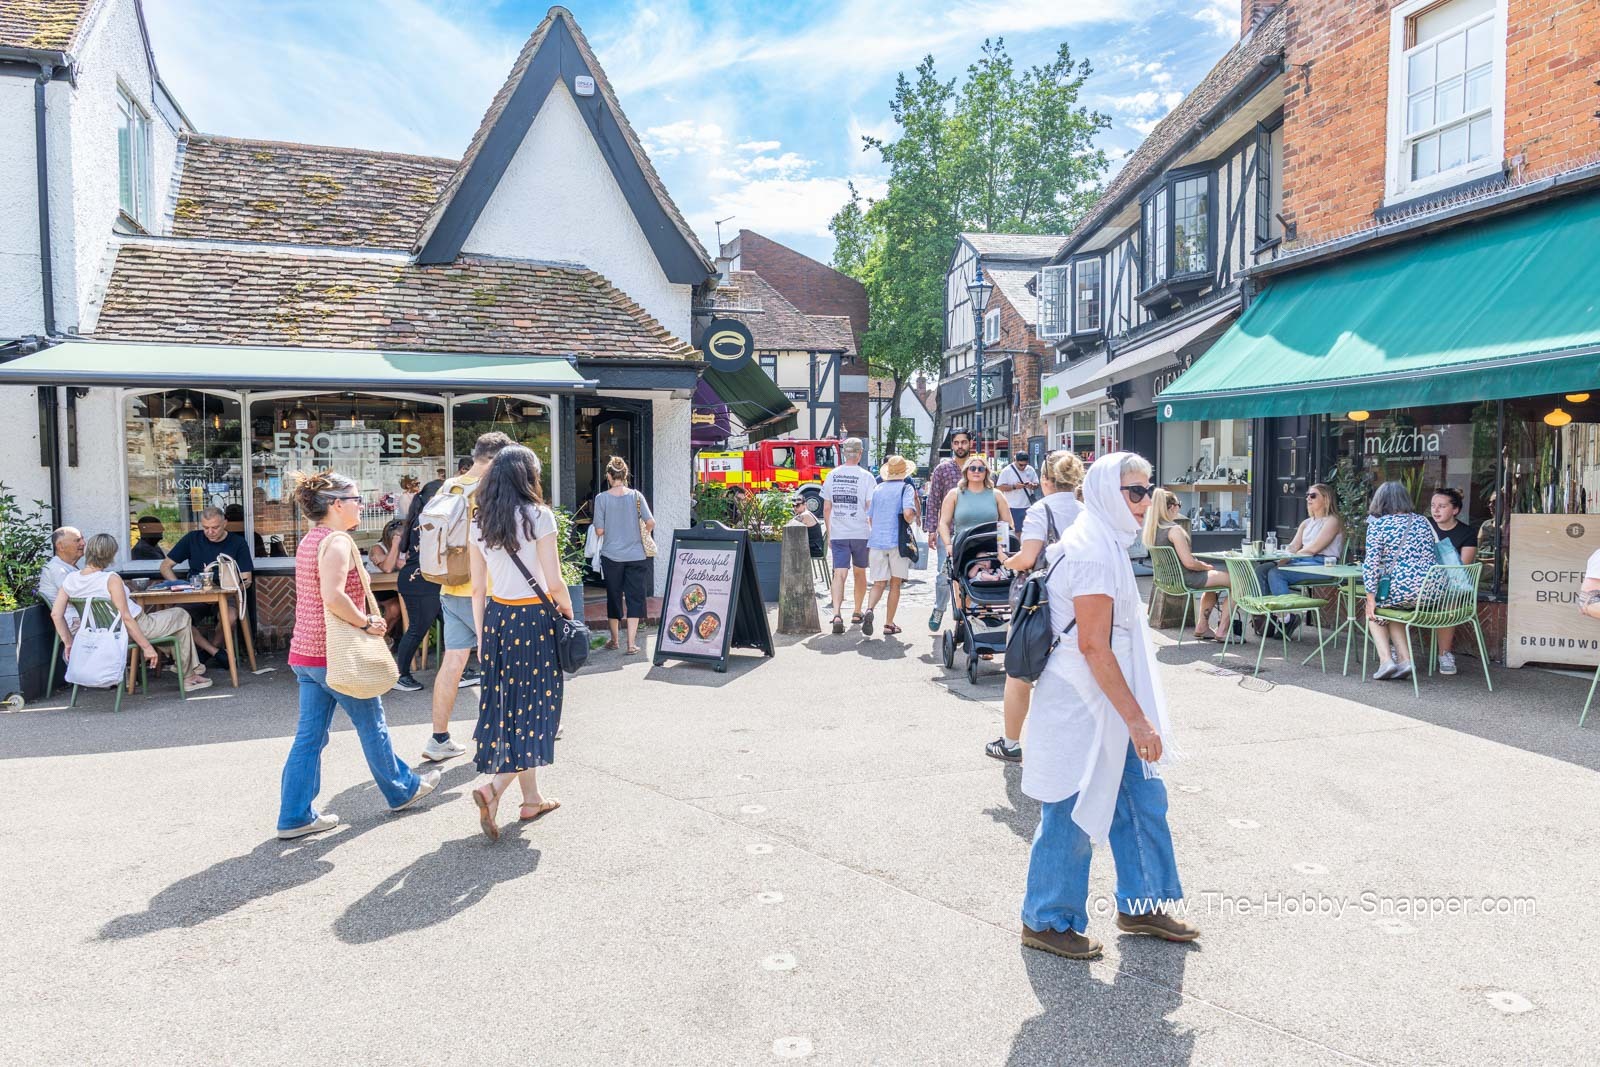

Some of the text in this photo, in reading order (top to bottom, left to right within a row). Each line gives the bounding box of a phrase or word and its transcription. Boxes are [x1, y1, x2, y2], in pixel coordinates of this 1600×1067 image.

[274, 432, 422, 454] ESQUIRES
[1364, 426, 1439, 454] matcha
[165, 478, 206, 490] PASSION
[1571, 526, 1580, 536] G
[679, 552, 730, 572] Flavourful
[682, 568, 732, 586] flatbreads
[1520, 636, 1599, 650] GROUNDWO
